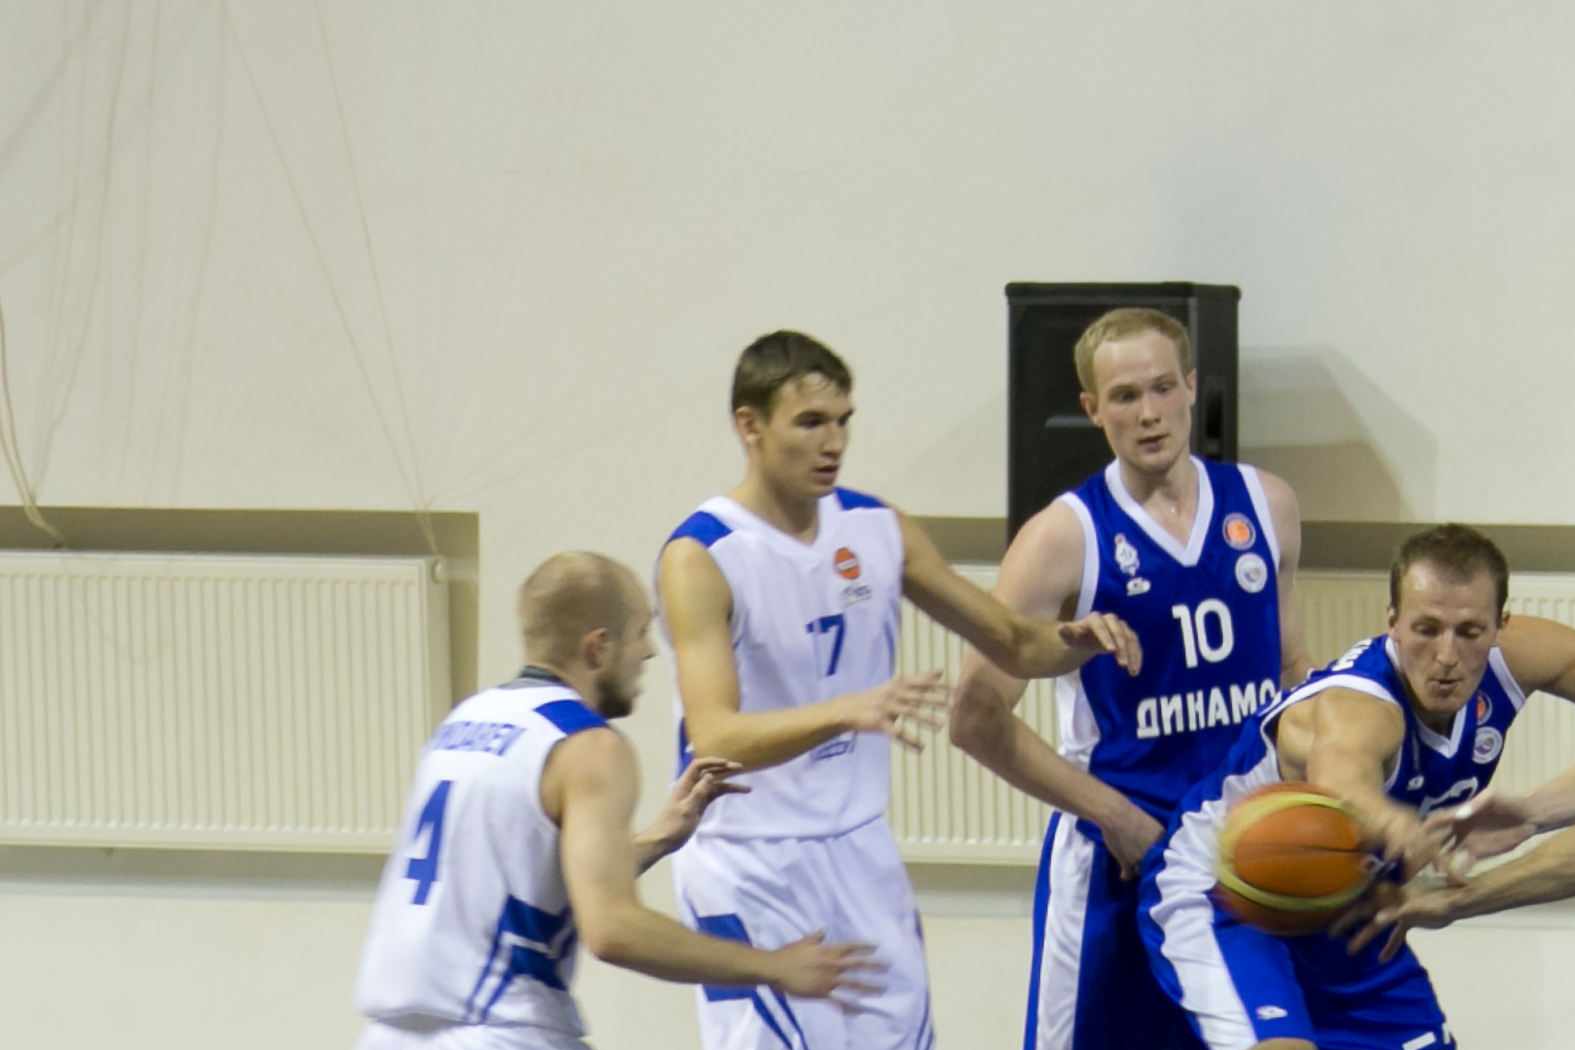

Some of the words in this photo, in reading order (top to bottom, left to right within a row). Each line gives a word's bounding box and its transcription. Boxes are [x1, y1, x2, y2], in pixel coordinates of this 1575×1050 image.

[806, 613, 845, 676] 7
[1171, 598, 1235, 668] 10
[403, 780, 453, 905] 4
